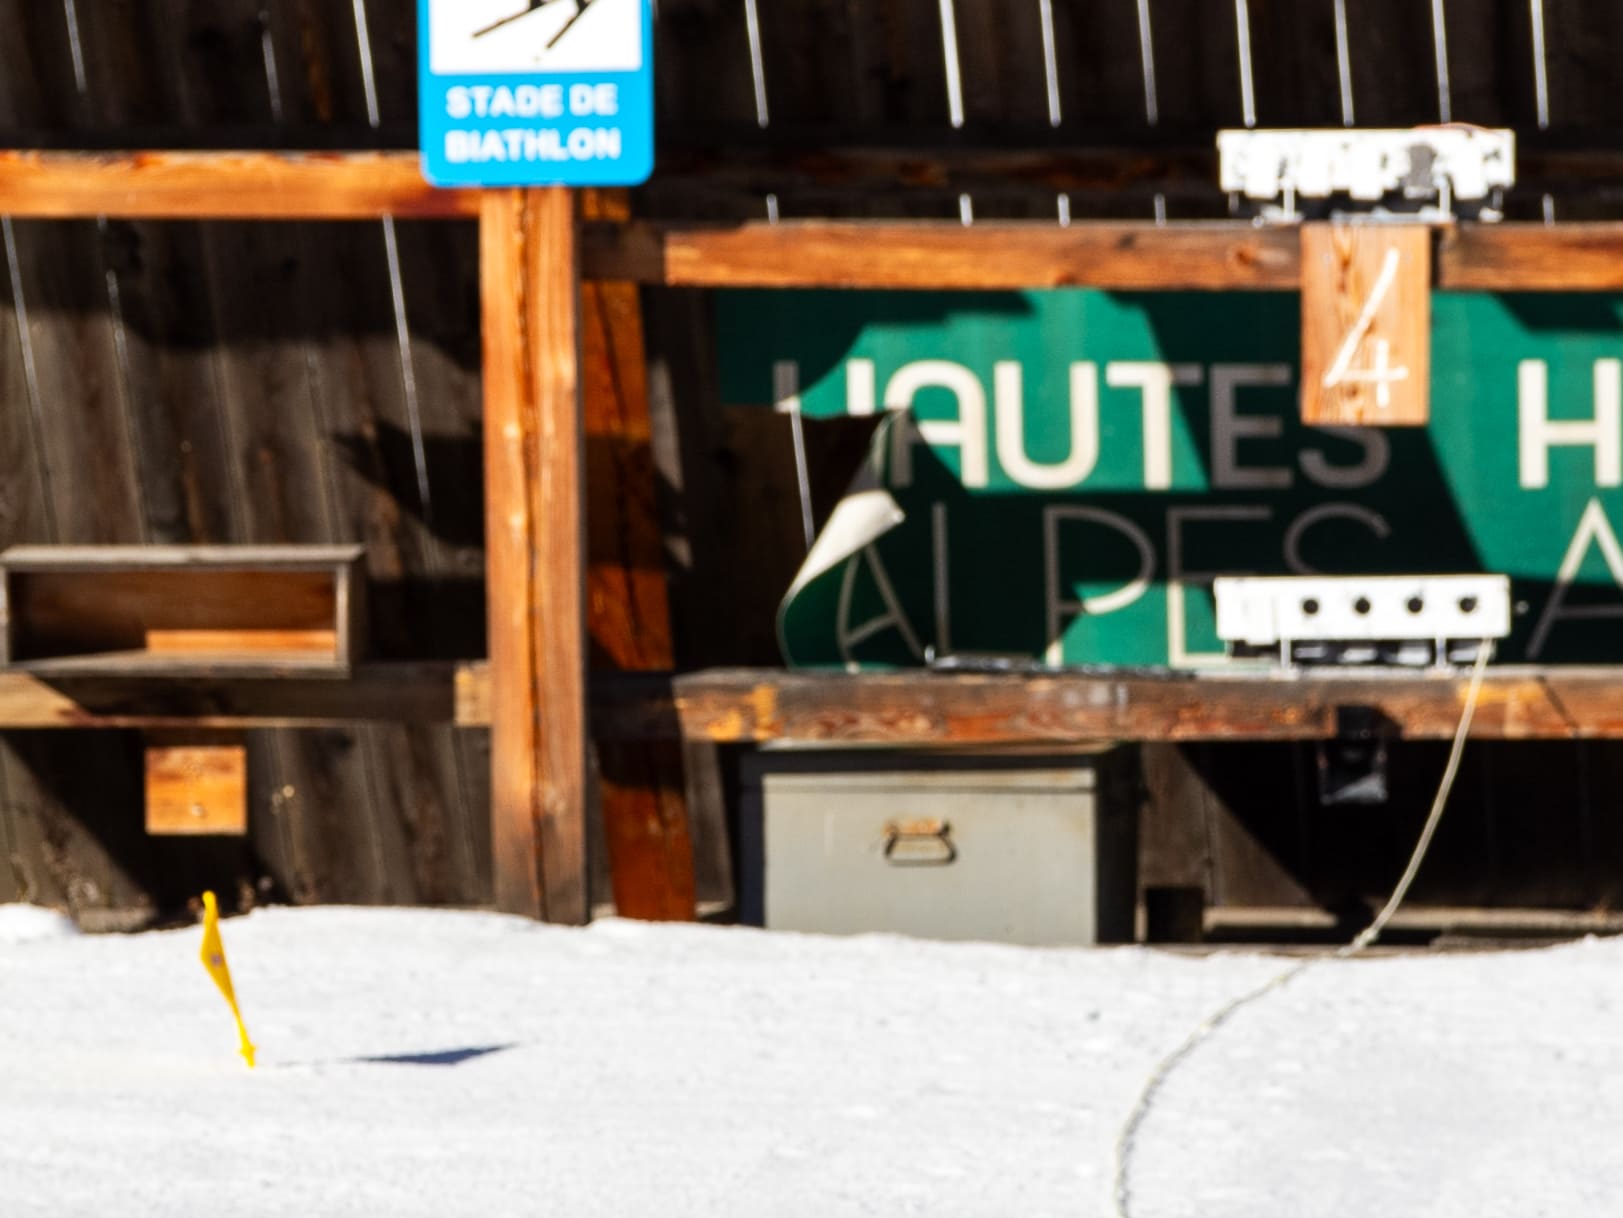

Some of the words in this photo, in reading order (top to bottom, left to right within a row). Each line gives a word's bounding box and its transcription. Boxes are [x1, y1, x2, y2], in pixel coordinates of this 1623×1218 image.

[445, 83, 565, 119] STADE
[569, 83, 619, 117] DE
[444, 127, 623, 163] BIATHLON
[1322, 246, 1409, 408] 4
